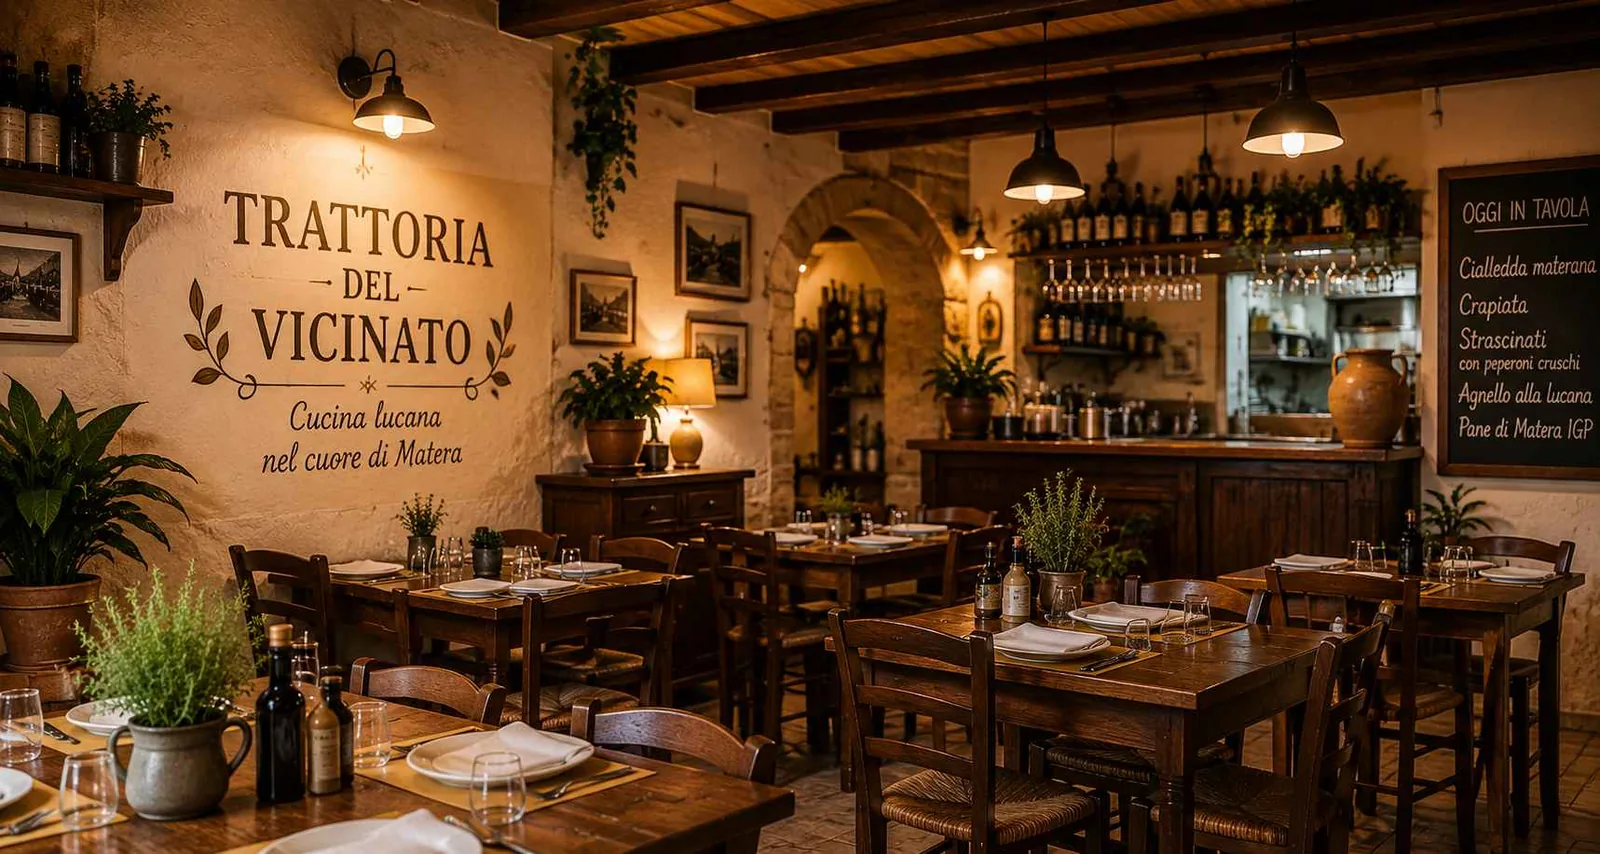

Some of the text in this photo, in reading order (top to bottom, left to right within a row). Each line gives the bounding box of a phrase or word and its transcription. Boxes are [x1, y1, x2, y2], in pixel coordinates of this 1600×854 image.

[1463, 196, 1589, 224] OGGI IN TAVOLA
[224, 190, 494, 268] TRATTORIA
[1460, 255, 1596, 279] Cialledda materana
[343, 267, 400, 302] DEL
[1460, 293, 1528, 321] Crapiata
[251, 309, 470, 365] VICINATO
[1460, 327, 1546, 349] Strascinati
[1459, 354, 1580, 376] con peperoni cruschi
[1459, 382, 1592, 410] Agnello alla lucana
[290, 400, 441, 431] Cucina lucana
[1460, 416, 1593, 439] Pane di Matera IGP
[261, 439, 462, 473] nel cuore di Matera
